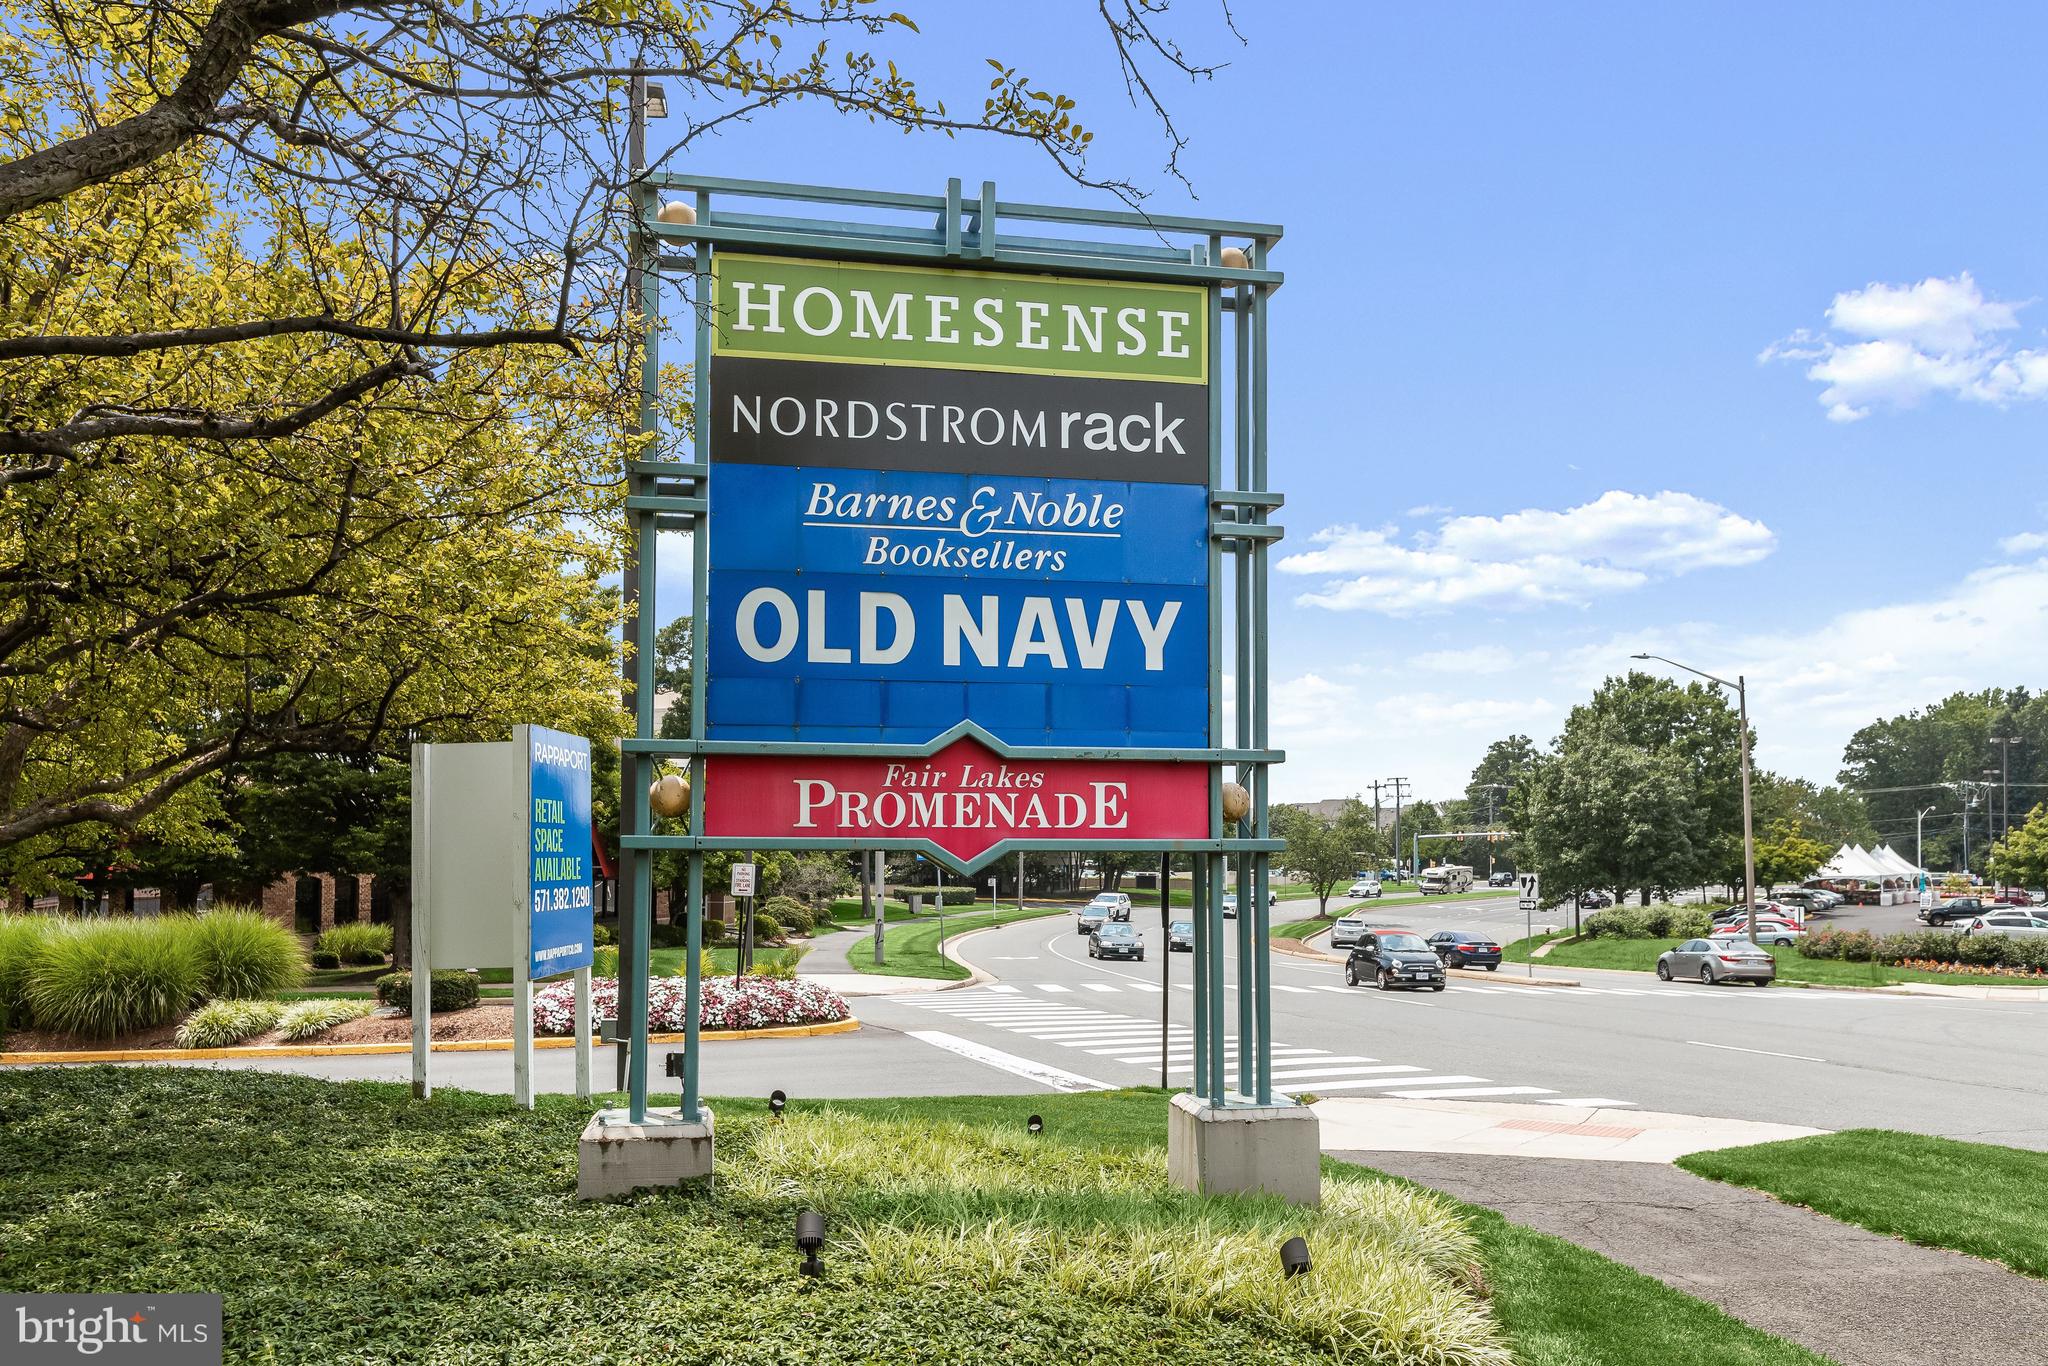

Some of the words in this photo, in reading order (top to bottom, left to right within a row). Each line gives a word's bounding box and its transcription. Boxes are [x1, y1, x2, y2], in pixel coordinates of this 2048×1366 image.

[731, 281, 1191, 359] HOMESENSE
[732, 394, 1048, 449] NORDSTROM
[1060, 401, 1187, 456] rack
[803, 482, 957, 522] Barnes
[959, 486, 1003, 538] &
[1003, 491, 1125, 529] Noble
[862, 535, 1068, 572] Booksellers
[735, 586, 917, 665] OLD
[942, 593, 1184, 672] NAVY
[534, 741, 588, 772] RAPPAPORT
[881, 763, 948, 788] Fair
[958, 764, 1046, 789] Lakes
[535, 798, 566, 825] RETAIL
[792, 778, 1129, 830] PROMENADE
[534, 828, 564, 853] SPACE
[534, 856, 582, 882] AVAILABLE
[534, 885, 591, 913] 571.382.1290
